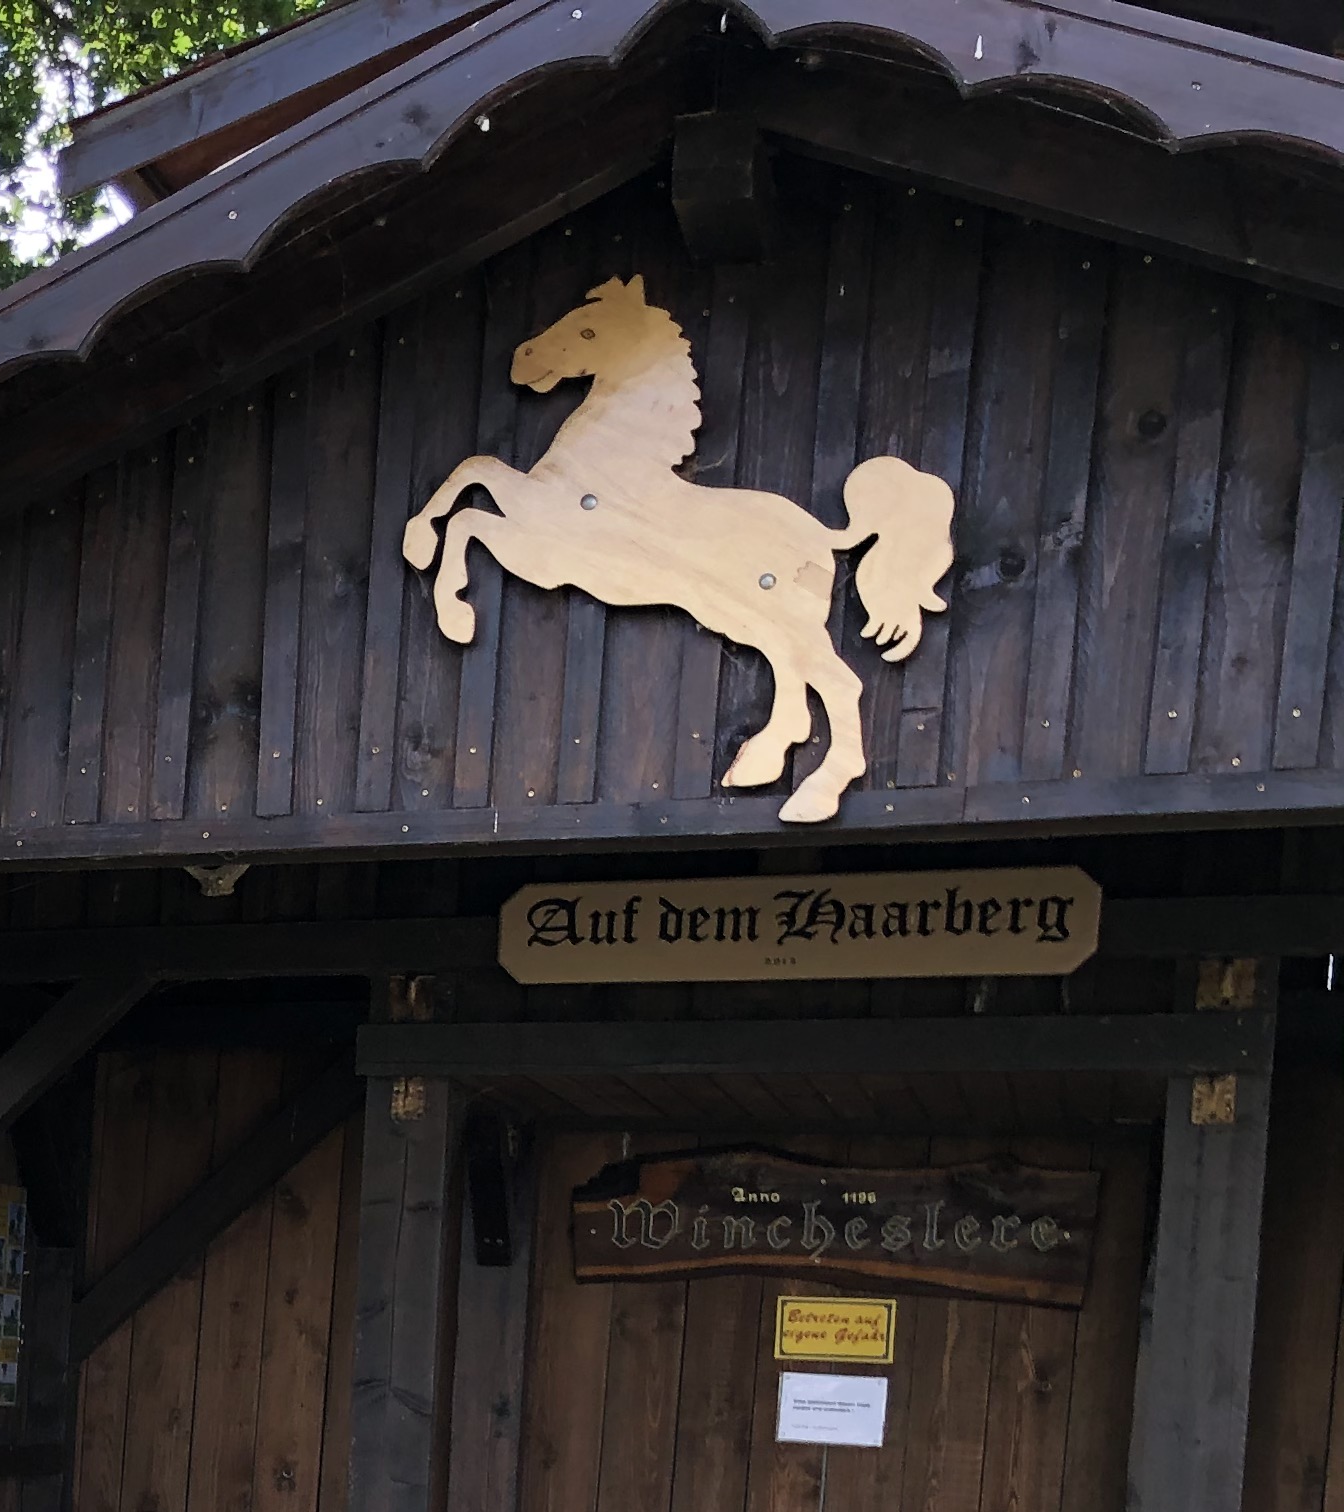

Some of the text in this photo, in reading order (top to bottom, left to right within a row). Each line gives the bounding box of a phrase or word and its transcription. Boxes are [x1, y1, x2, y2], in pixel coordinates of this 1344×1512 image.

[527, 886, 1075, 946] Auf dem Haarberg
[788, 1309, 881, 1329] Betreten auf
[784, 1327, 885, 1345] eigene Gefahr
